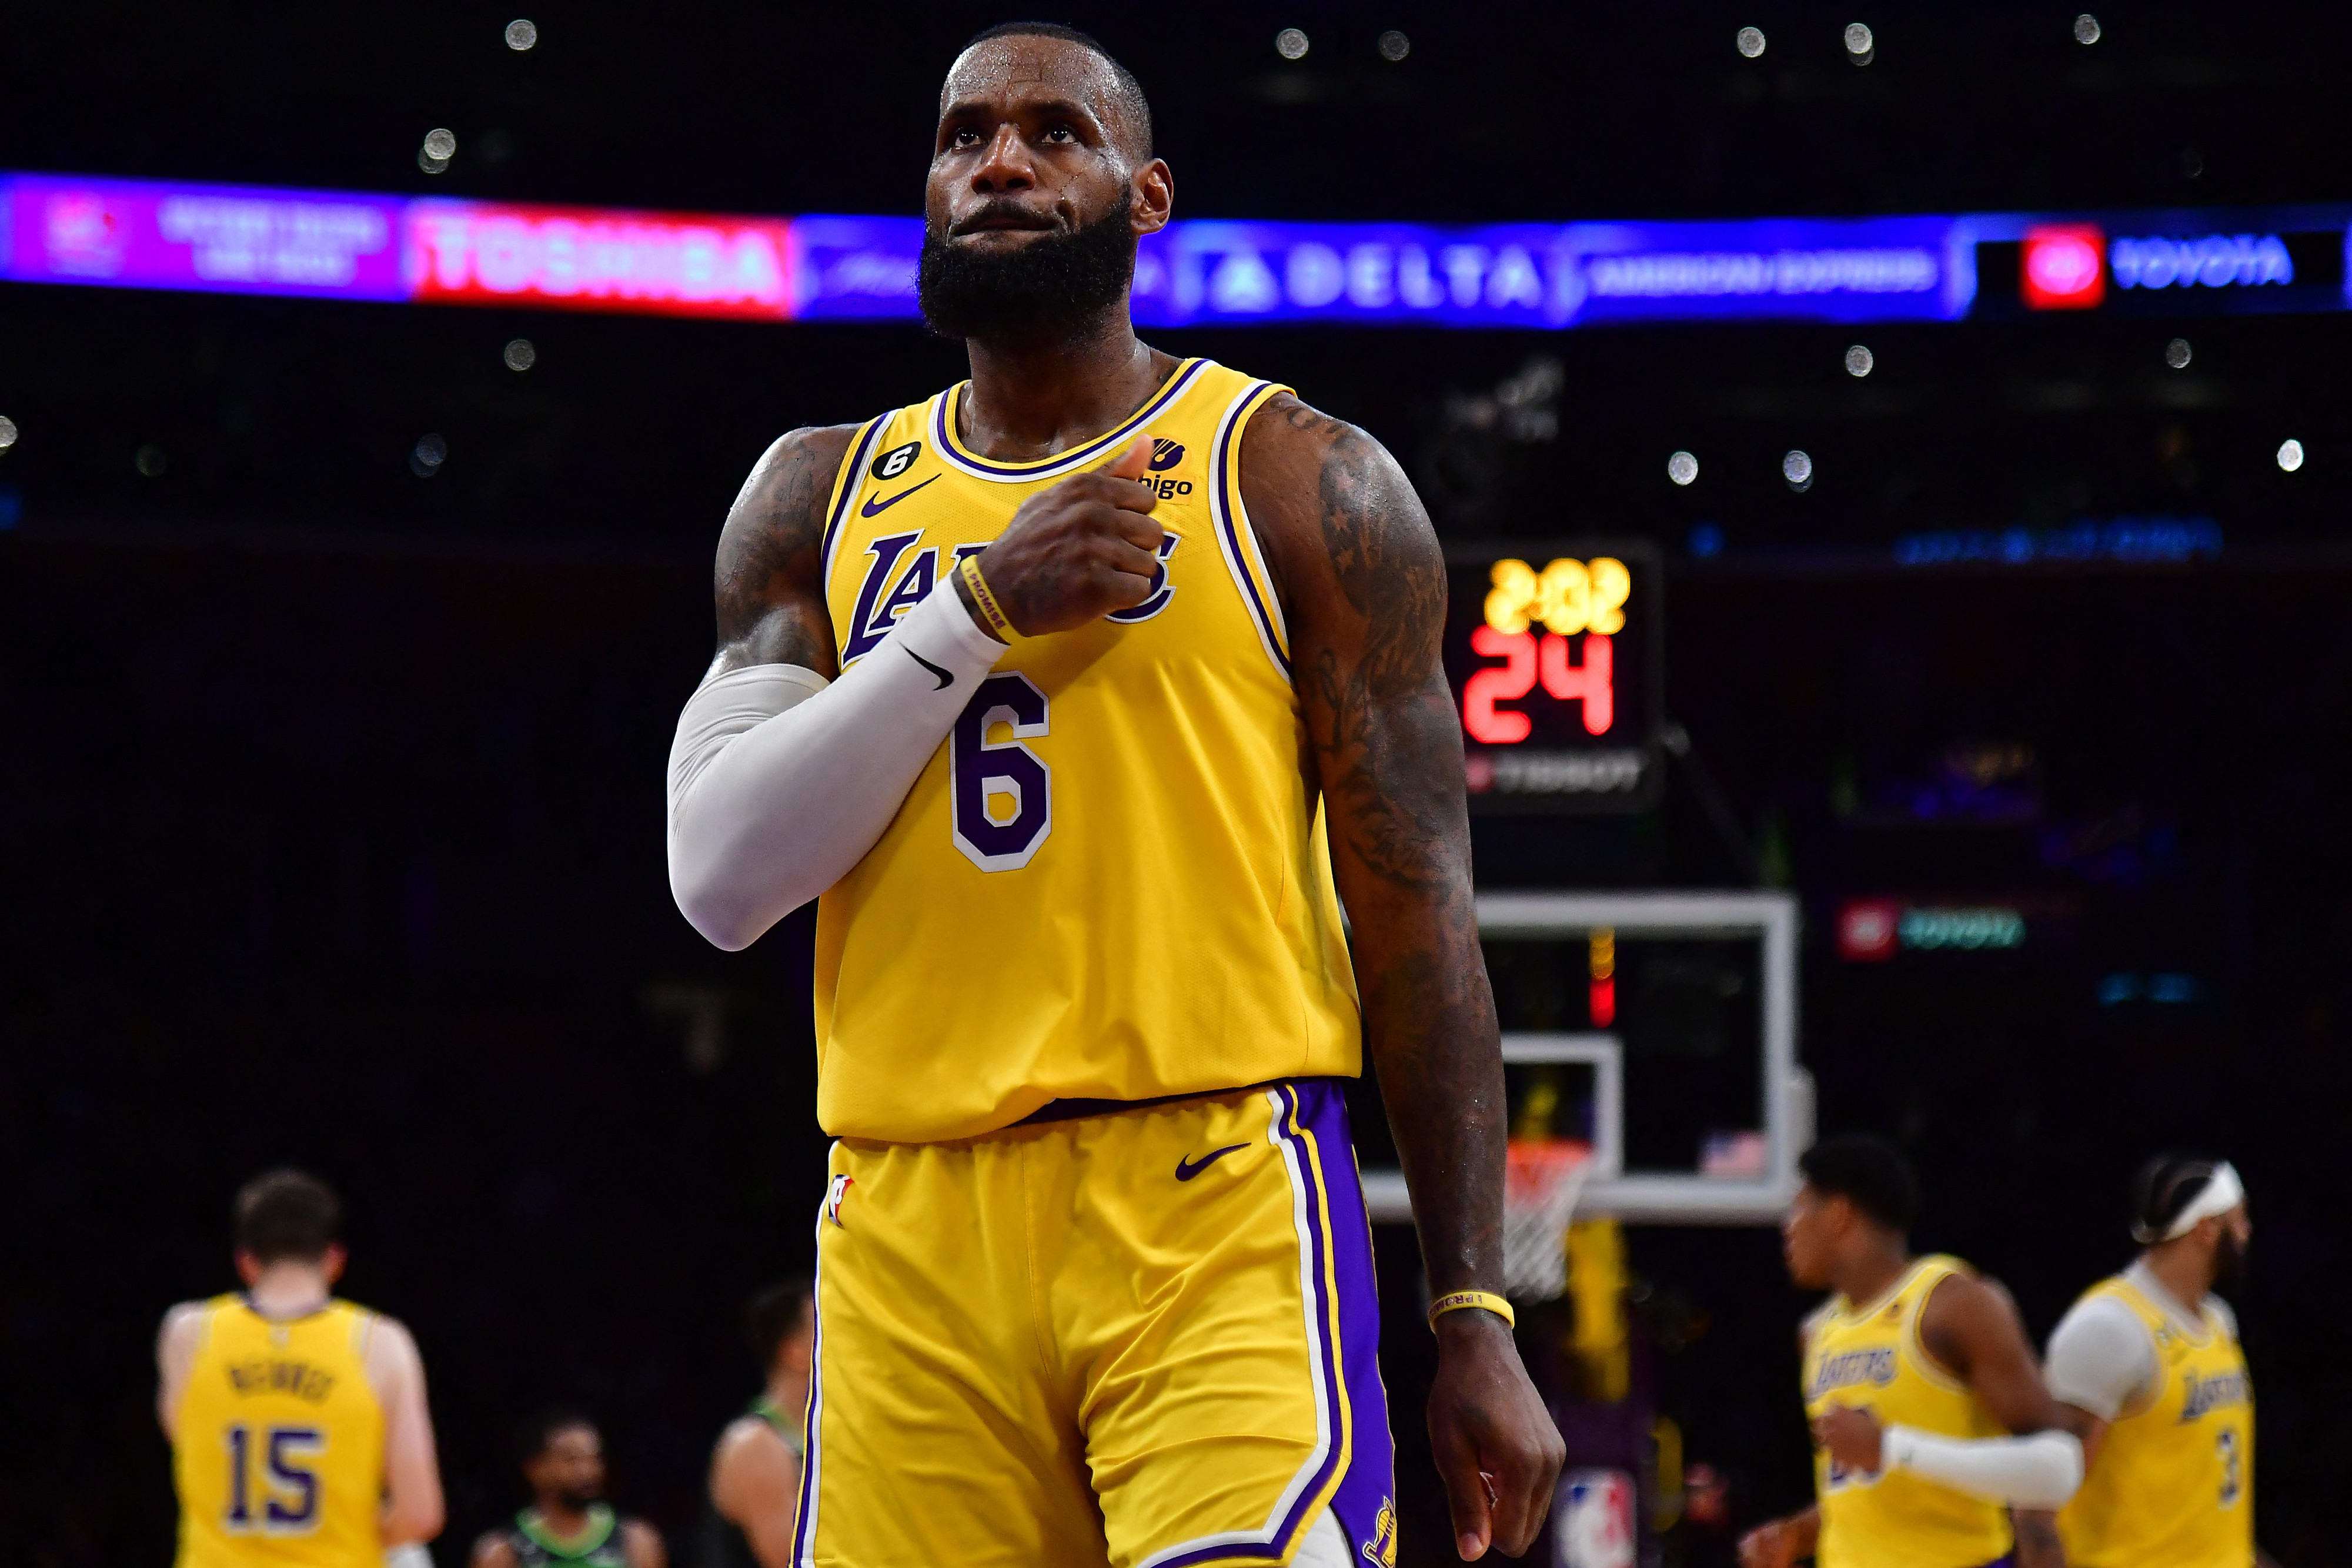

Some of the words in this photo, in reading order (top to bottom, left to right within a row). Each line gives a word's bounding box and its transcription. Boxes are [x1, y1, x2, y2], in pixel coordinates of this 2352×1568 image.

[416, 214, 783, 302] TOSHIBA
[1288, 240, 1542, 310] DELTA
[2109, 234, 2293, 289] TOYOTA
[882, 446, 913, 476] 6
[1484, 557, 1631, 636] 2:02
[1464, 623, 1614, 744] 24
[950, 670, 1052, 874] 6
[226, 1425, 326, 1534] 15
[2216, 1427, 2241, 1512] 3
